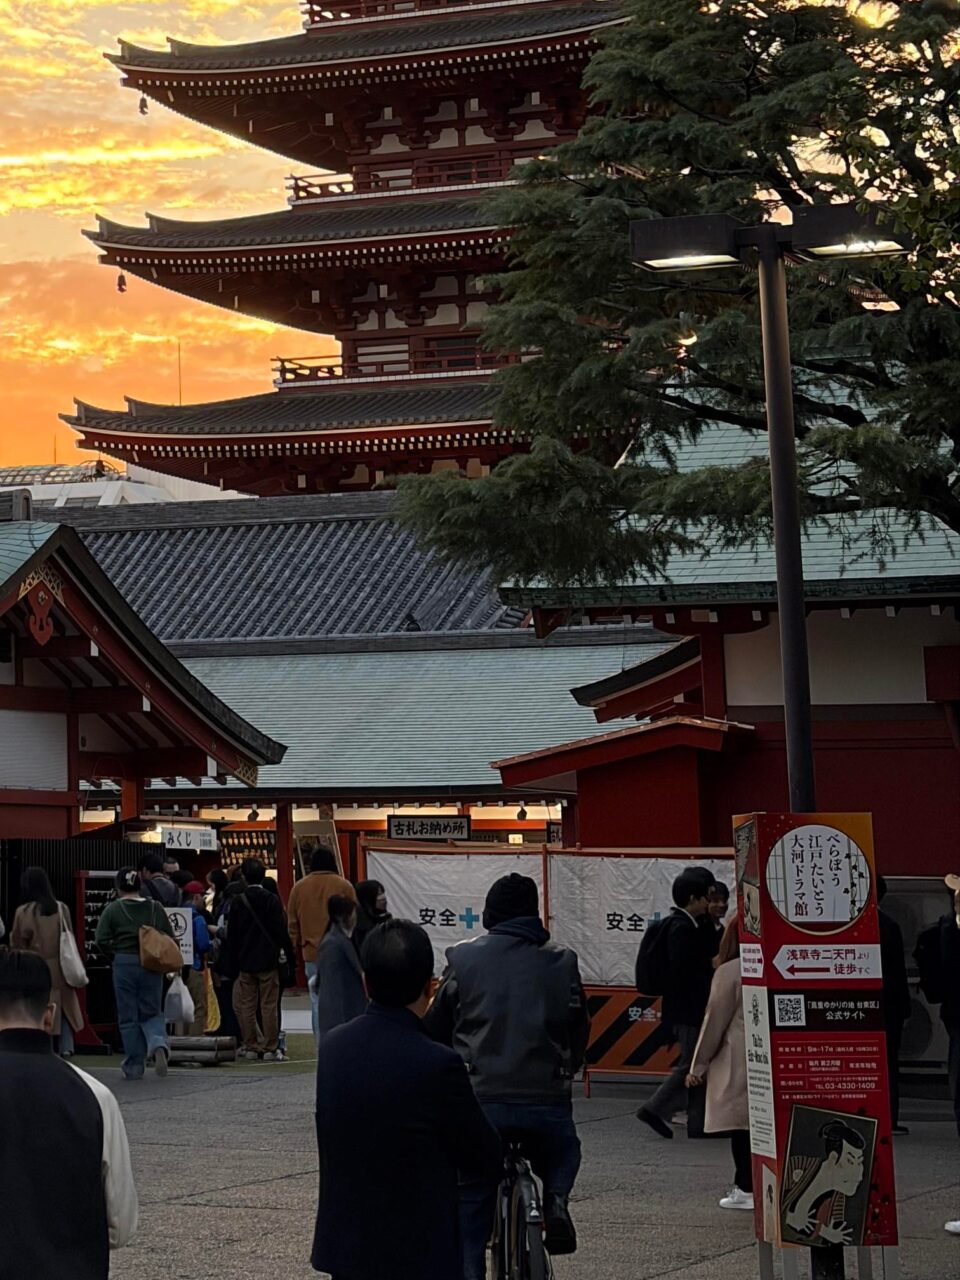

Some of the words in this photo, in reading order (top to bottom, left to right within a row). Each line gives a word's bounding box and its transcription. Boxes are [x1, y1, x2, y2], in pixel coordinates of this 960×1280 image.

[393, 820, 465, 836] 古札お納め所
[167, 831, 192, 847] みくじ
[826, 834, 843, 887] べらぼう
[791, 834, 809, 917] 大河ドラマ館
[808, 835, 825, 917] 江戸たいとう
[419, 907, 457, 928] 安全
[606, 911, 645, 932] 安全
[627, 1006, 657, 1022] 安全
[825, 1010, 866, 1020] 公式サイト
